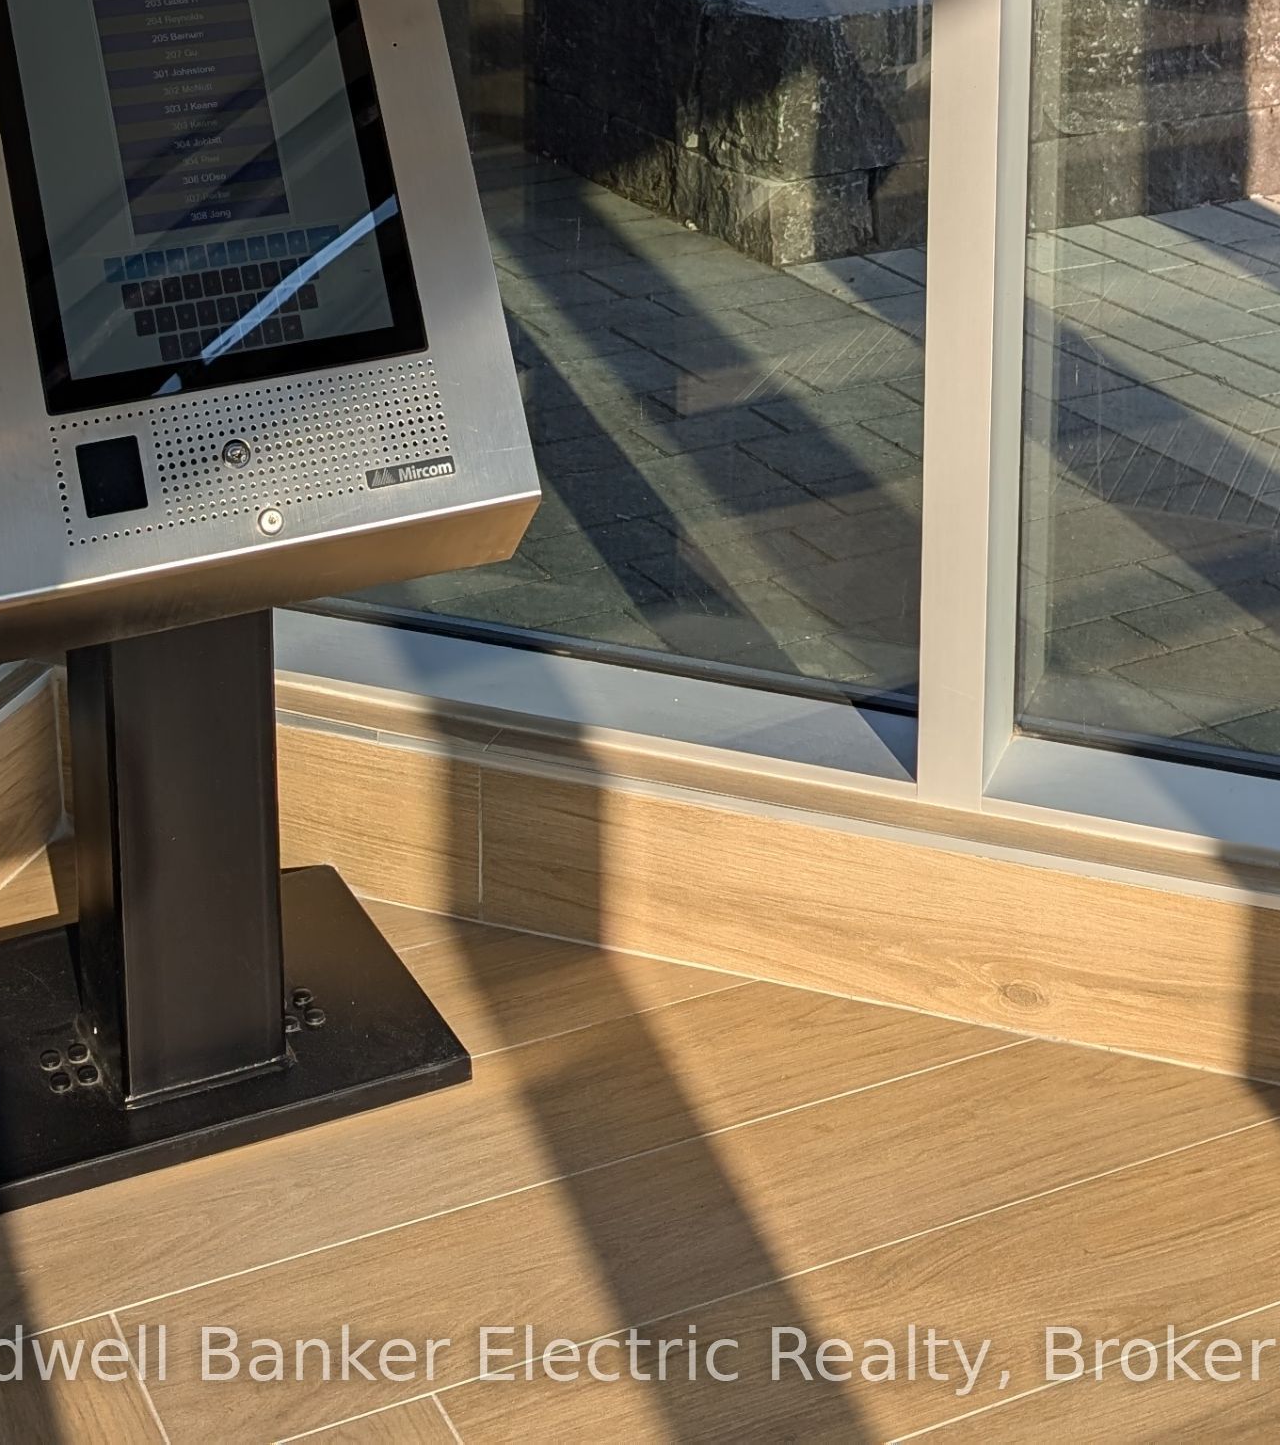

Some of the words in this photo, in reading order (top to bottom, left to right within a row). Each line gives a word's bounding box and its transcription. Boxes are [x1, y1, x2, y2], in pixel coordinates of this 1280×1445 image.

[151, 33, 169, 43] 205
[152, 69, 169, 79] 301
[171, 65, 216, 77] Johnstone
[164, 104, 181, 114] 303
[398, 462, 453, 482] Mircom
